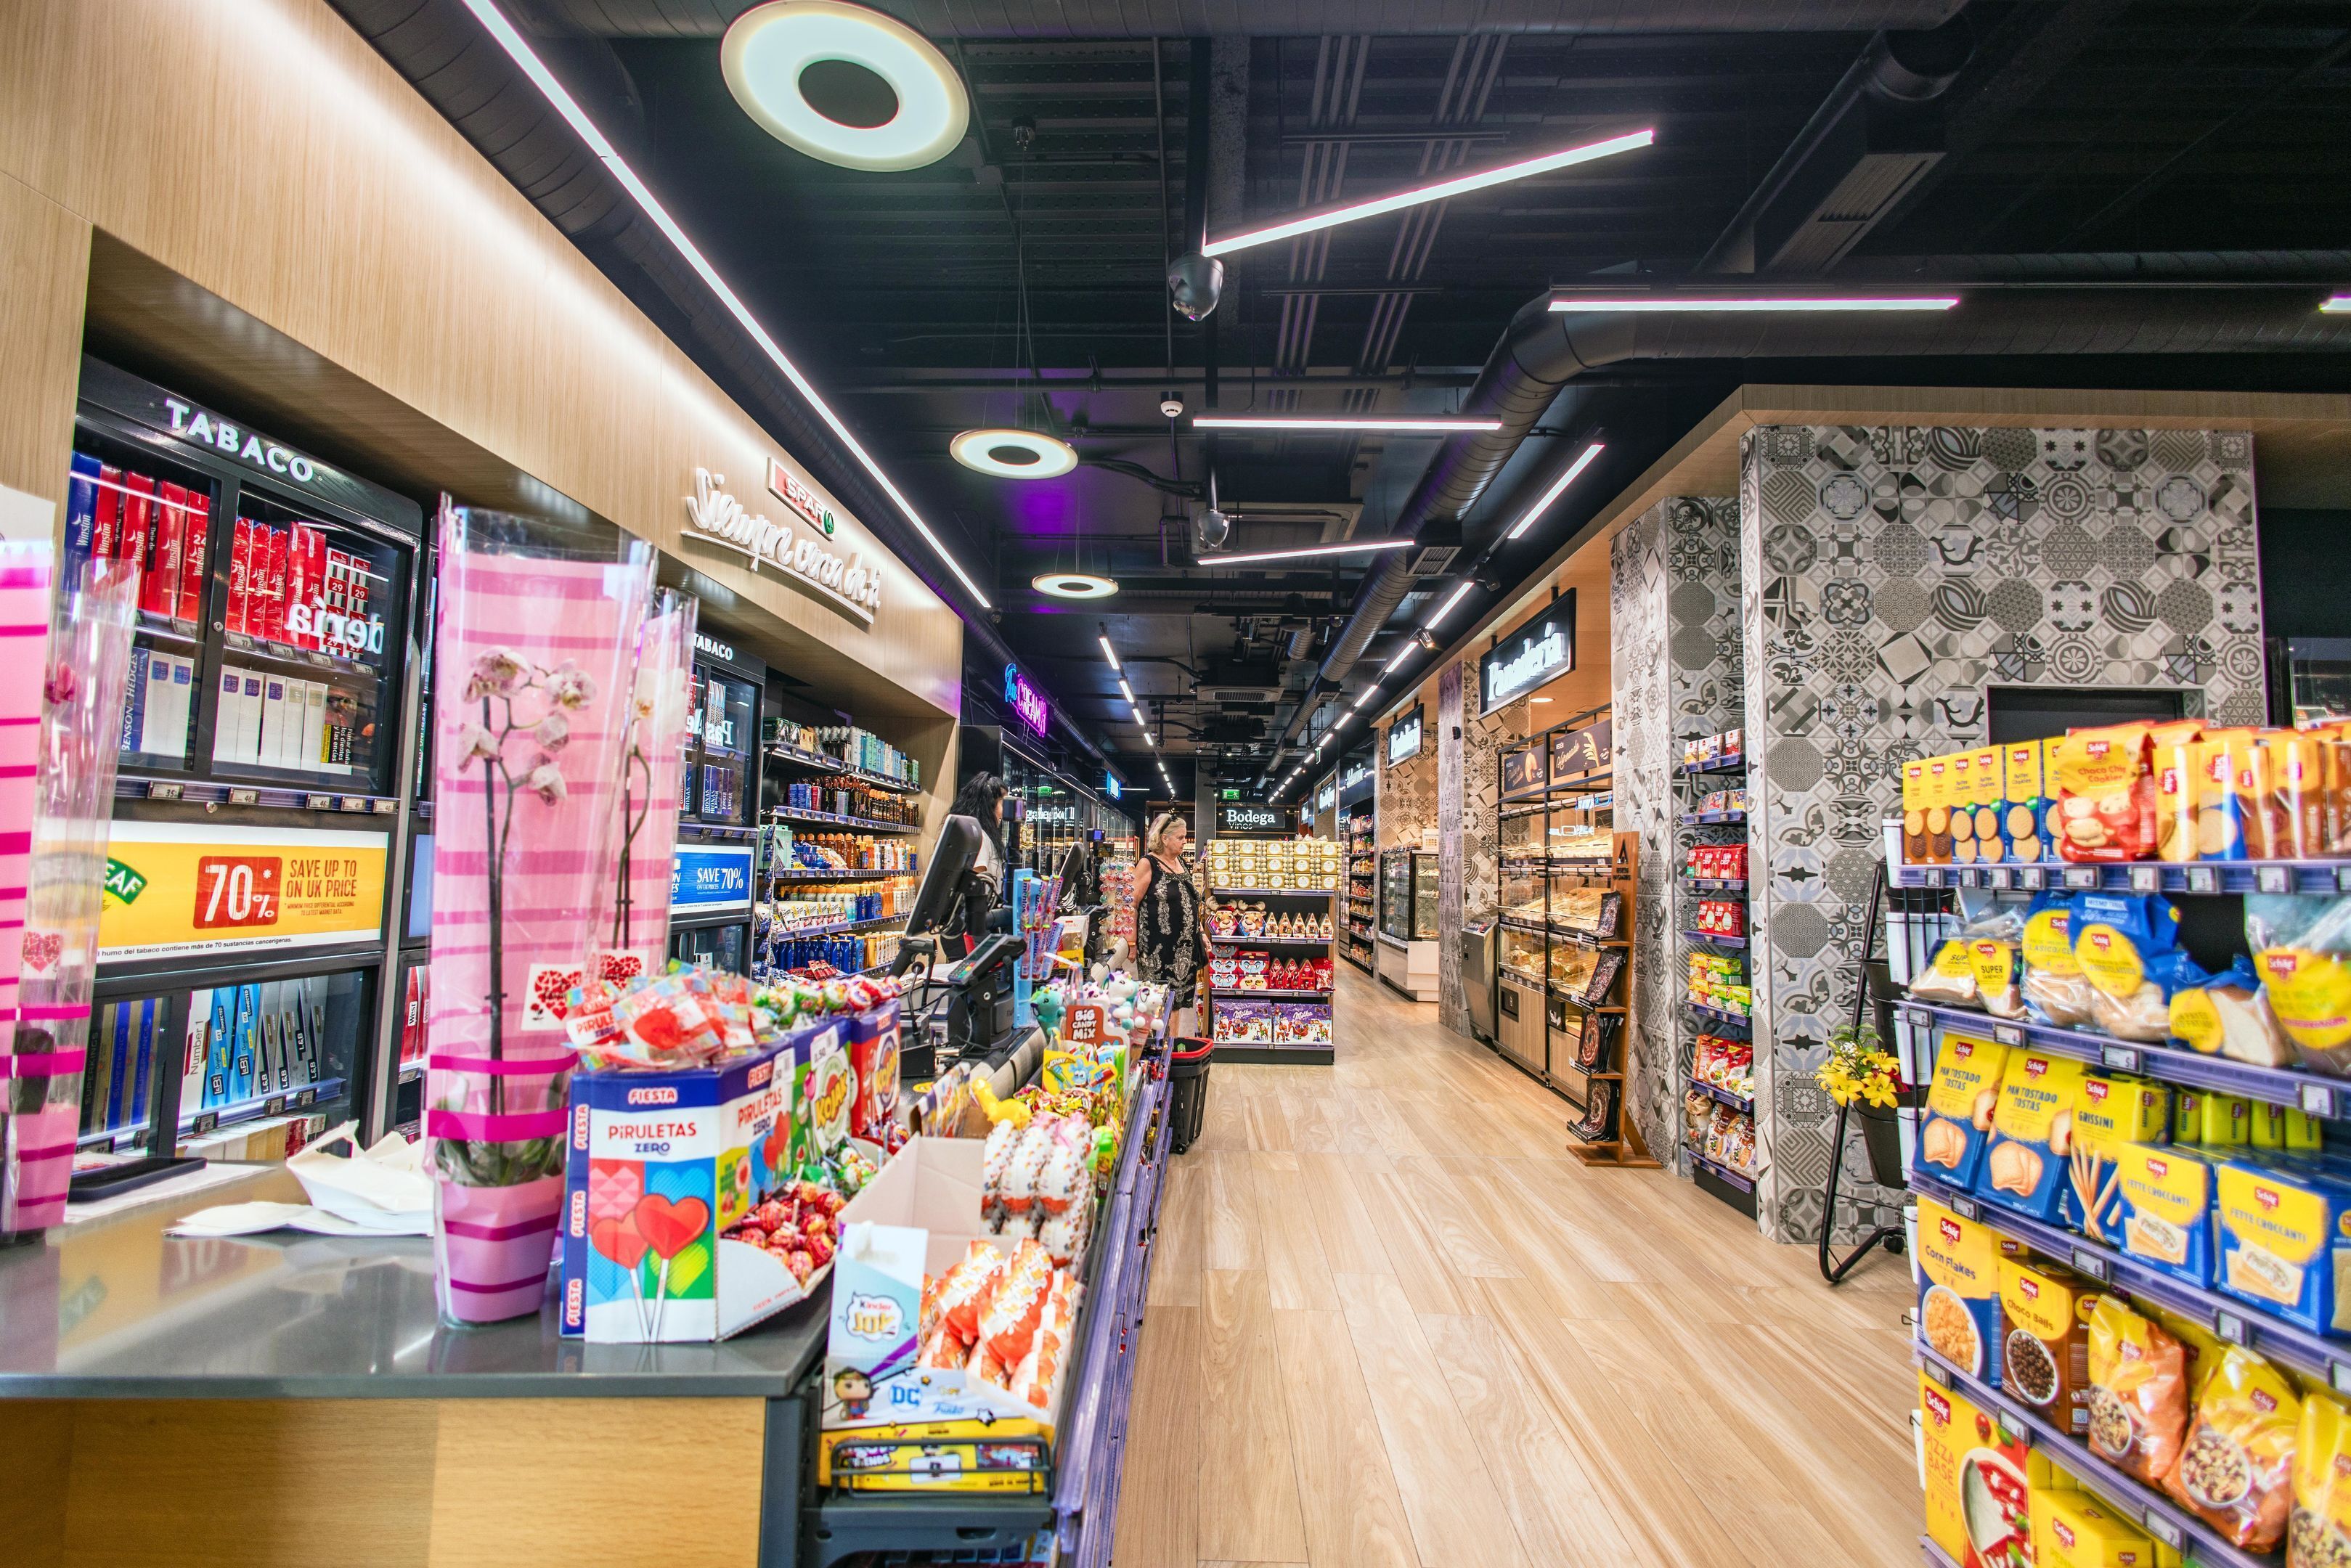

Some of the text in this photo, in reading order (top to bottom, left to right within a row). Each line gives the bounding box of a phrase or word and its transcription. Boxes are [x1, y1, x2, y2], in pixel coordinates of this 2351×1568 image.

[166, 398, 313, 481] TABACO
[784, 476, 826, 525] SPAR
[76, 515, 91, 546] Winston
[97, 523, 112, 555] Winston
[132, 531, 144, 562] Winston
[166, 539, 179, 569] Winston
[192, 547, 205, 576] Winston
[234, 563, 245, 592] Winston
[255, 568, 266, 597] Winston
[272, 574, 282, 601] Winston
[332, 582, 343, 592] 29
[293, 577, 303, 604] Winston
[354, 589, 365, 598] 29
[693, 633, 733, 661] TABACO
[121, 653, 138, 750] BENSON HEDGES
[2087, 743, 2108, 754] Schär
[2078, 766, 2106, 775] Choco
[1226, 809, 1275, 825] Bodega
[1229, 821, 1252, 830] Vinos
[290, 859, 357, 878] SAVE UP TO
[697, 867, 720, 883] SAVE
[720, 867, 743, 890] 70%
[286, 879, 357, 899] ON UK PRICE
[1981, 965, 2003, 974] SUPER
[1072, 1020, 1097, 1029] CANDY
[1232, 1009, 1253, 1019] Milka
[1292, 1009, 1313, 1020] Milka
[190, 1030, 203, 1075] Number
[1955, 1044, 1973, 1056] Schär
[85, 1032, 99, 1105] SUPERKINGS
[875, 1049, 898, 1094] KOJAK
[1939, 1066, 1981, 1083] PAN TOSTADO
[2026, 1060, 2047, 1074] Schär
[629, 1087, 677, 1104] FIESTA
[1944, 1078, 1966, 1091] TOSTAS
[2007, 1085, 2058, 1104] PAN TOSTADO
[2086, 1081, 2108, 1098] Schär
[815, 1069, 848, 1130] KOJAK
[2013, 1097, 2041, 1112] TOSTAS
[574, 1104, 590, 1151] FIESTA
[754, 1116, 770, 1135] ZERO
[2078, 1111, 2114, 1130] GRISSINI
[634, 1143, 671, 1156] ZERO
[2127, 1178, 2191, 1208] FETTE CROCCANTI
[571, 1191, 586, 1238] FIESTA
[2230, 1208, 2307, 1243] FETTE CROCCANTI
[1940, 1220, 1960, 1241] Schär
[1925, 1244, 1976, 1281] Corn Flakes
[2021, 1280, 2038, 1297] Schär
[567, 1278, 582, 1327] FIESTA
[855, 1312, 895, 1334] JOY
[2007, 1298, 2054, 1331] Choco Balls
[890, 1385, 920, 1405] DC
[1926, 1390, 1950, 1420] Schär
[1925, 1432, 1956, 1470] PIZZA
[1928, 1455, 1954, 1485] BASE
